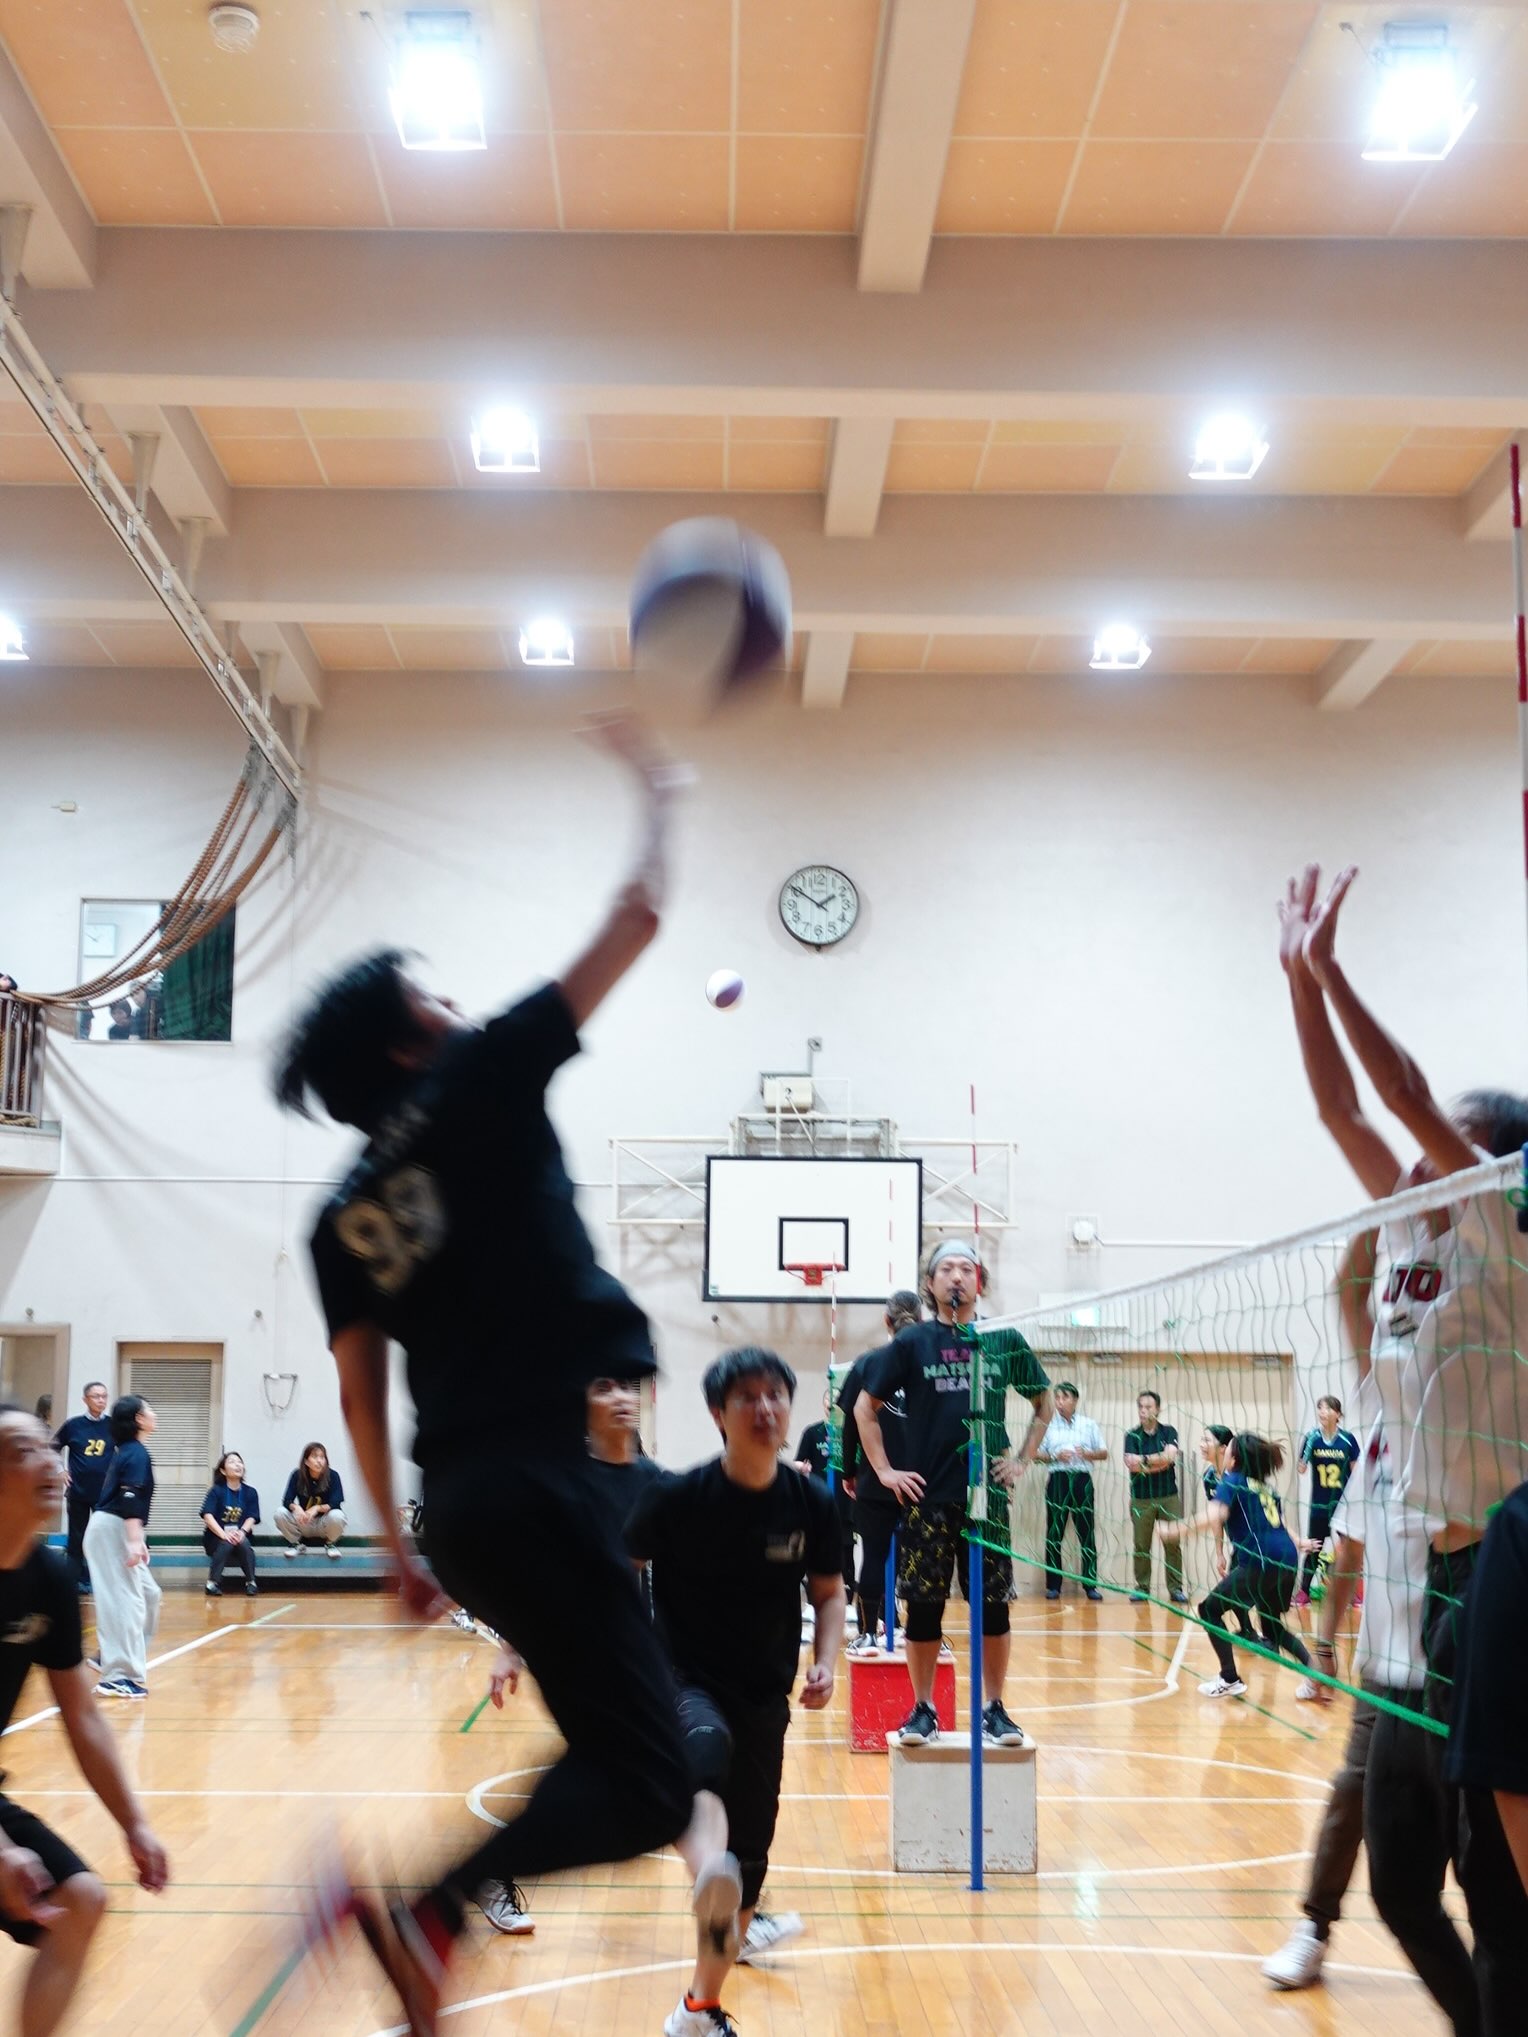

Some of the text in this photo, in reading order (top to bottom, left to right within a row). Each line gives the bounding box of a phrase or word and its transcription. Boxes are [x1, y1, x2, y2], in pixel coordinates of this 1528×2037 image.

[814, 873, 826, 886] 12
[831, 877, 837, 890] 1
[839, 885, 847, 898] 2
[787, 899, 798, 911] 9
[841, 898, 851, 911] 3
[791, 911, 801, 923] 8
[837, 912, 846, 923] 4
[801, 921, 811, 932] 7
[813, 924, 823, 937] 5
[828, 921, 837, 933] 6
[934, 1377, 993, 1392] BEAH
[84, 1439, 106, 1457] 29
[1316, 1463, 1343, 1488] 12
